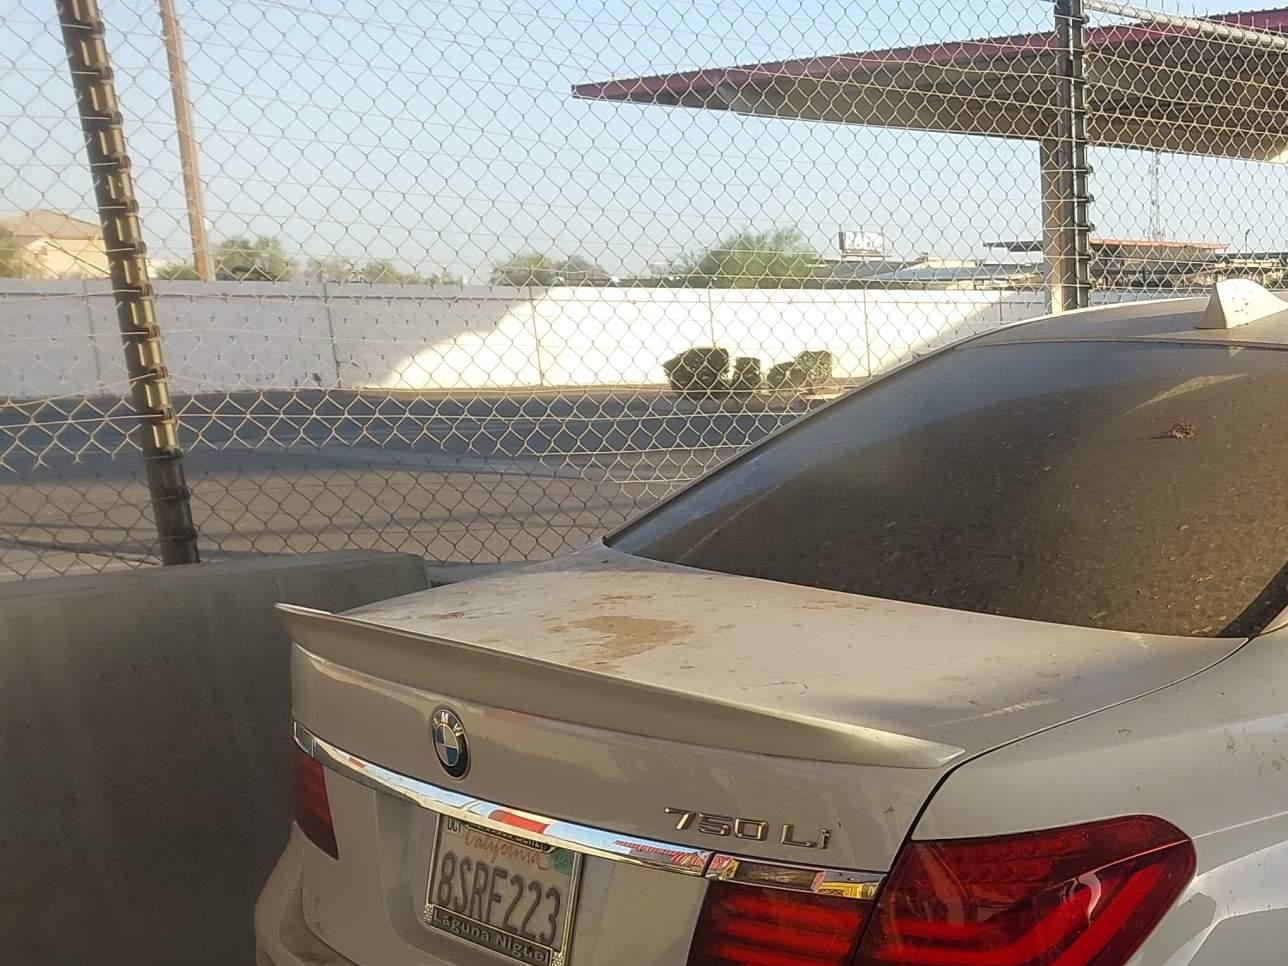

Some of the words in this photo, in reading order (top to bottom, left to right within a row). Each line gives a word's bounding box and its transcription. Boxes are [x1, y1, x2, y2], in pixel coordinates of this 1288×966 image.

[464, 830, 549, 870] California
[664, 807, 769, 841] 750
[780, 823, 831, 849] Li
[437, 851, 561, 947] 8SRF223
[434, 908, 490, 943] Laguna
[496, 935, 549, 965] Niguel
